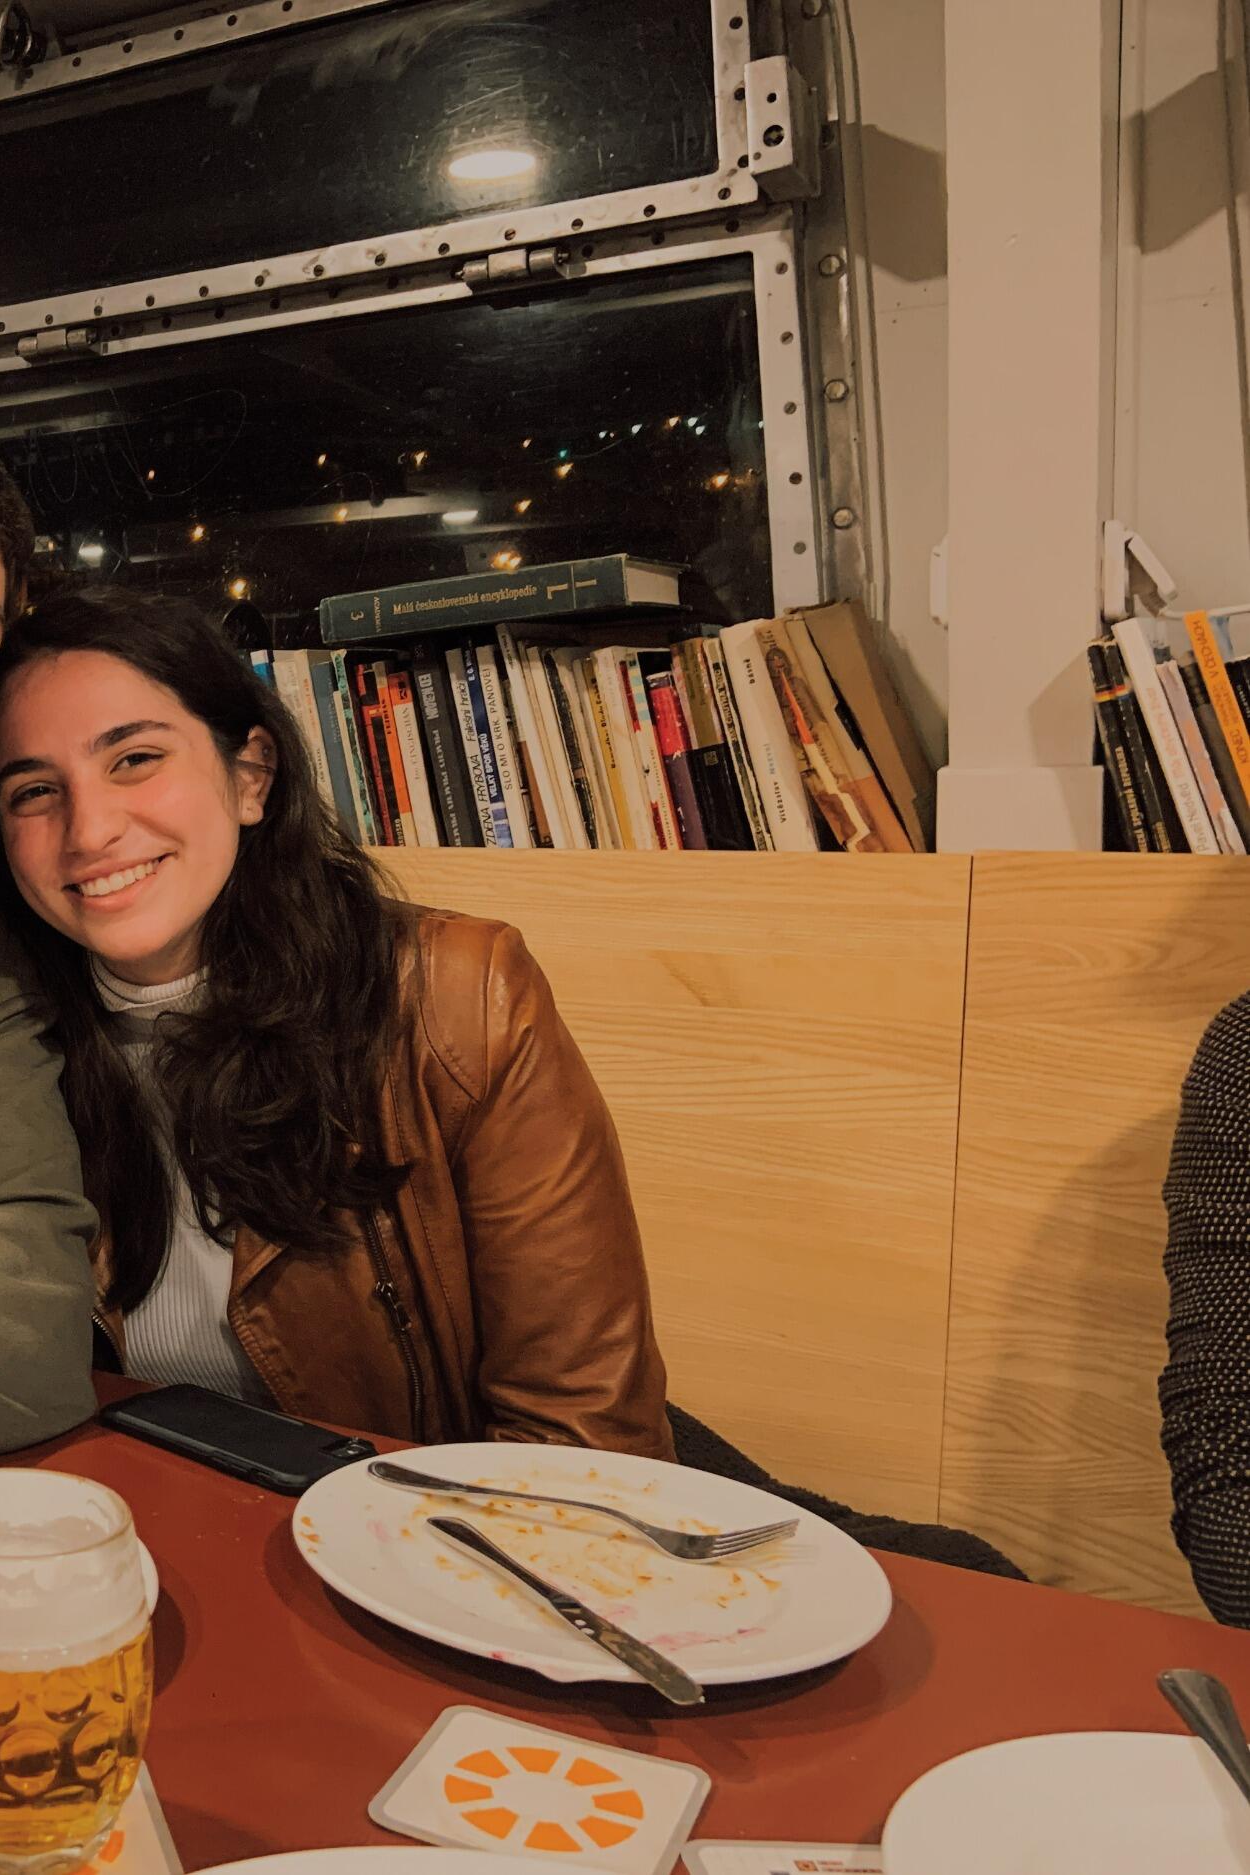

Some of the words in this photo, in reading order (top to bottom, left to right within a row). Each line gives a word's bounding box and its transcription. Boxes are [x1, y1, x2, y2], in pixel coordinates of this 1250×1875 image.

[393, 598, 414, 615] Malá
[415, 591, 479, 612] československá
[480, 584, 537, 603] encyklopedie
[477, 732, 489, 752] VĚKŮ
[482, 752, 494, 773] SPOR
[499, 753, 508, 766] MI
[484, 773, 498, 798] VELKÝ
[480, 807, 496, 846] ZDENA
